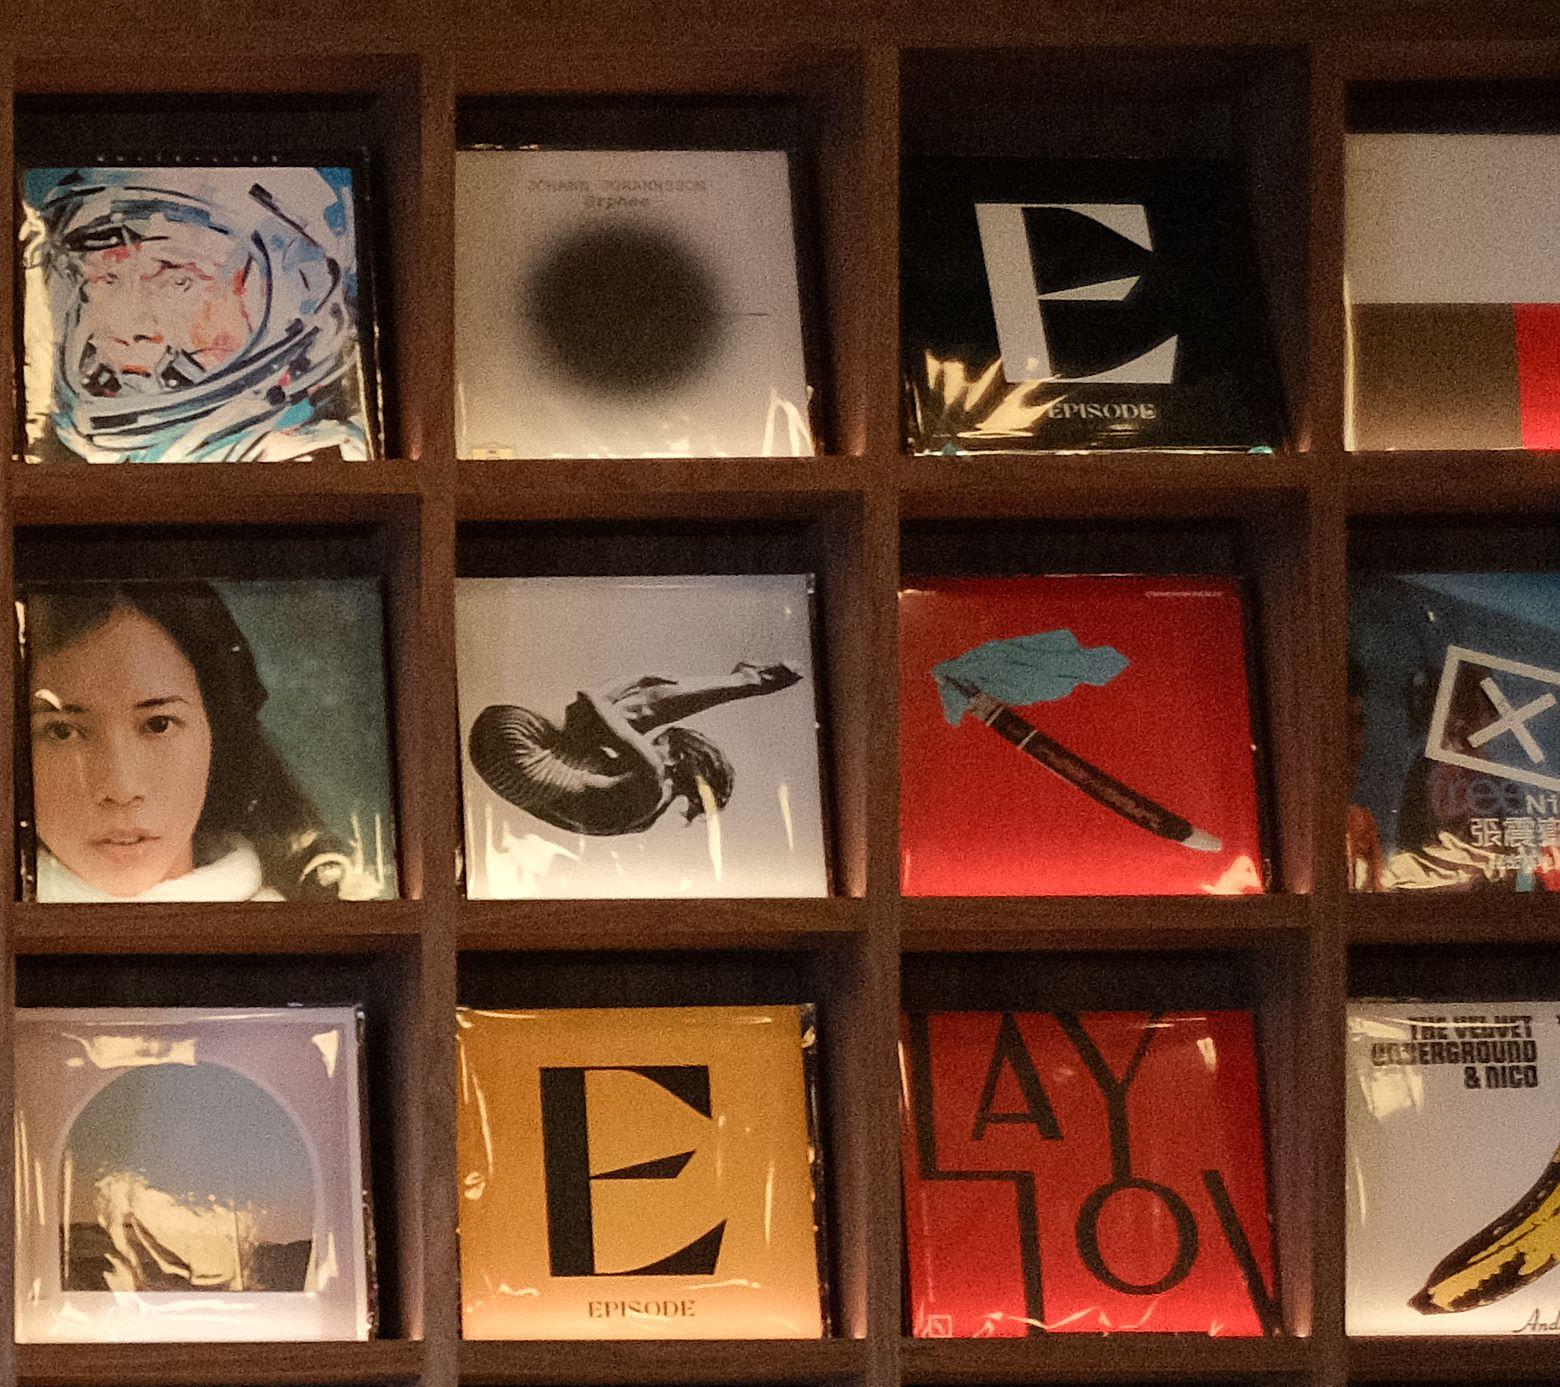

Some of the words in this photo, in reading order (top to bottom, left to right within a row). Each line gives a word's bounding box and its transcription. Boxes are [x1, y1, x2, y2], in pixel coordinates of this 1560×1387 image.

[975, 203, 1181, 384] E
[1047, 402, 1158, 421] EPISODE
[1369, 1039, 1539, 1067] UNDERGROUND
[1462, 1066, 1482, 1089] &
[539, 1064, 727, 1277] E
[587, 1299, 697, 1320] EPISODE
